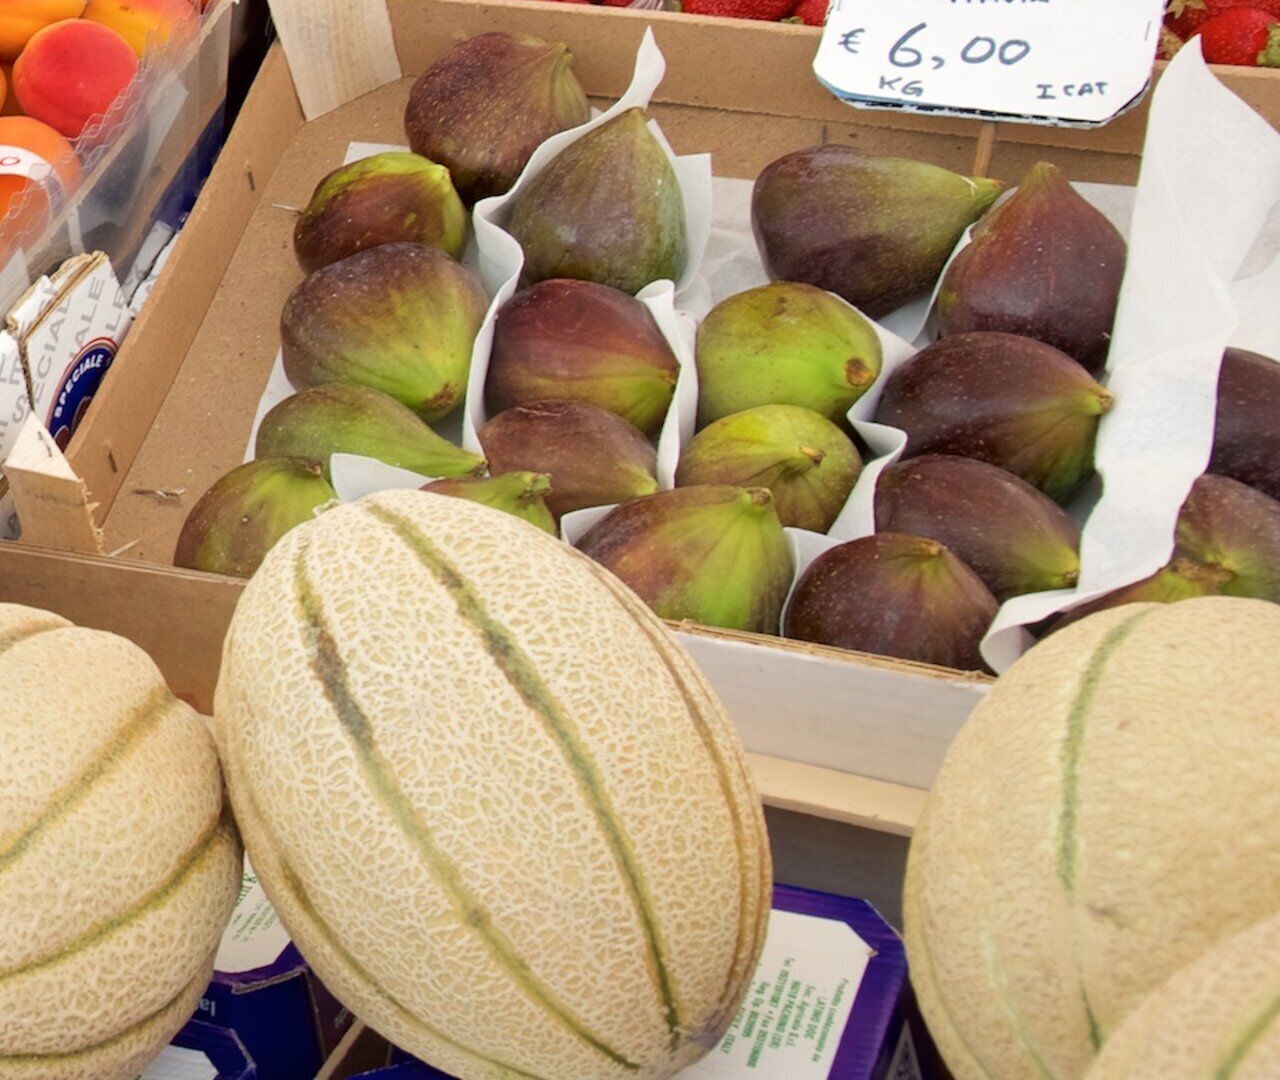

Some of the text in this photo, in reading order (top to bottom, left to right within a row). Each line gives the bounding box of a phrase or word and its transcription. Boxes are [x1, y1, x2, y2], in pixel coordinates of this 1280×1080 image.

[838, 23, 1031, 70] € 6,00
[879, 76, 924, 97] KG
[54, 353, 104, 418] SPECIALE
